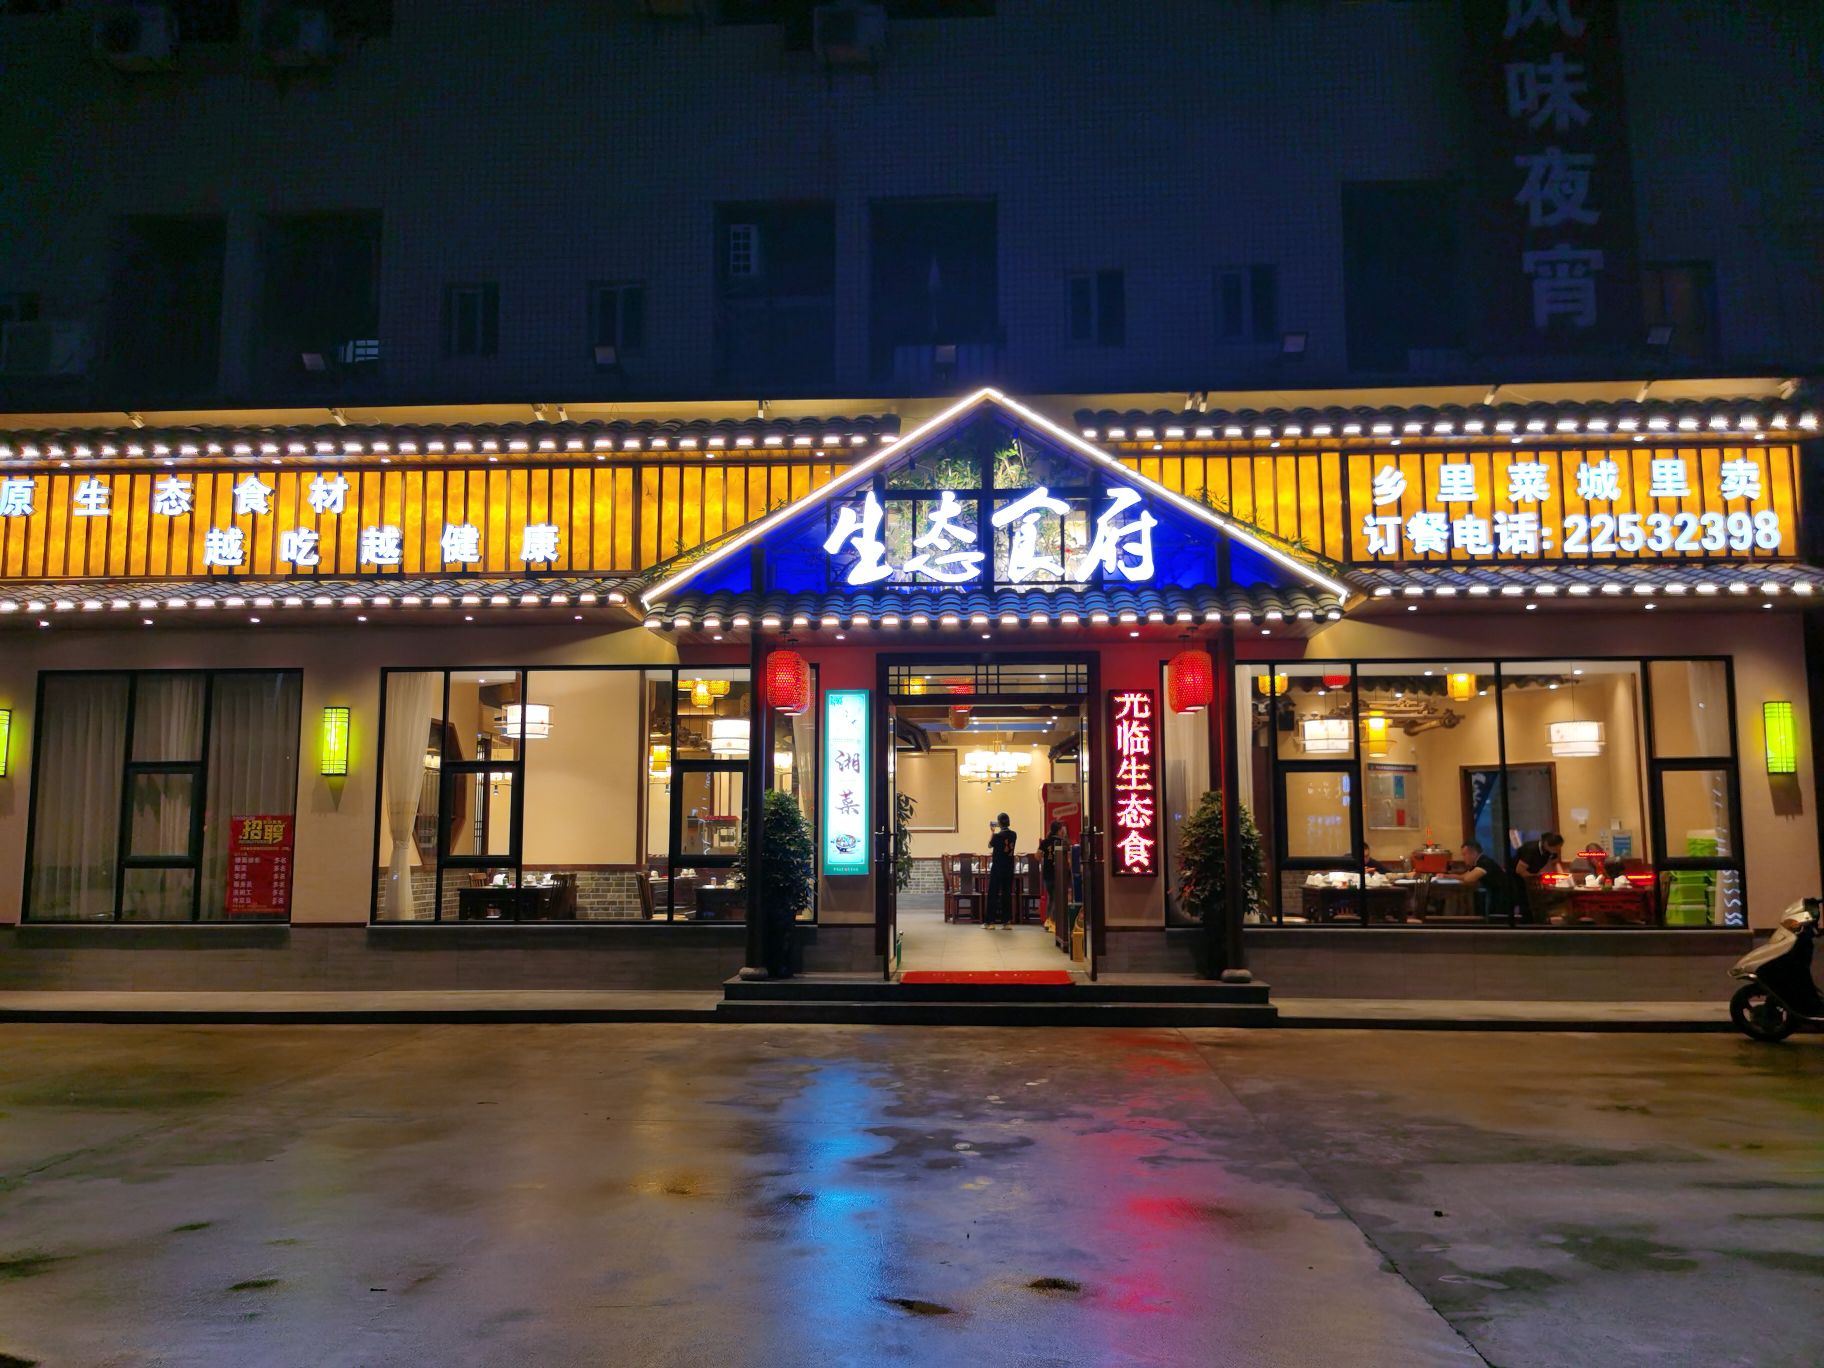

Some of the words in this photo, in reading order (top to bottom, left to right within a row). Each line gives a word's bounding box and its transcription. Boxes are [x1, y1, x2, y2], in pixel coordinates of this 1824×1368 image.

[0, 476, 349, 517] 原生态食材
[1372, 458, 1762, 506] 乡里菜城里卖
[204, 523, 560, 568] 越吃越健康
[823, 487, 1157, 585] 生态食府
[834, 749, 862, 816] 湘菜
[1114, 692, 1155, 874] 光临生态食
[241, 820, 285, 844] 招聘
